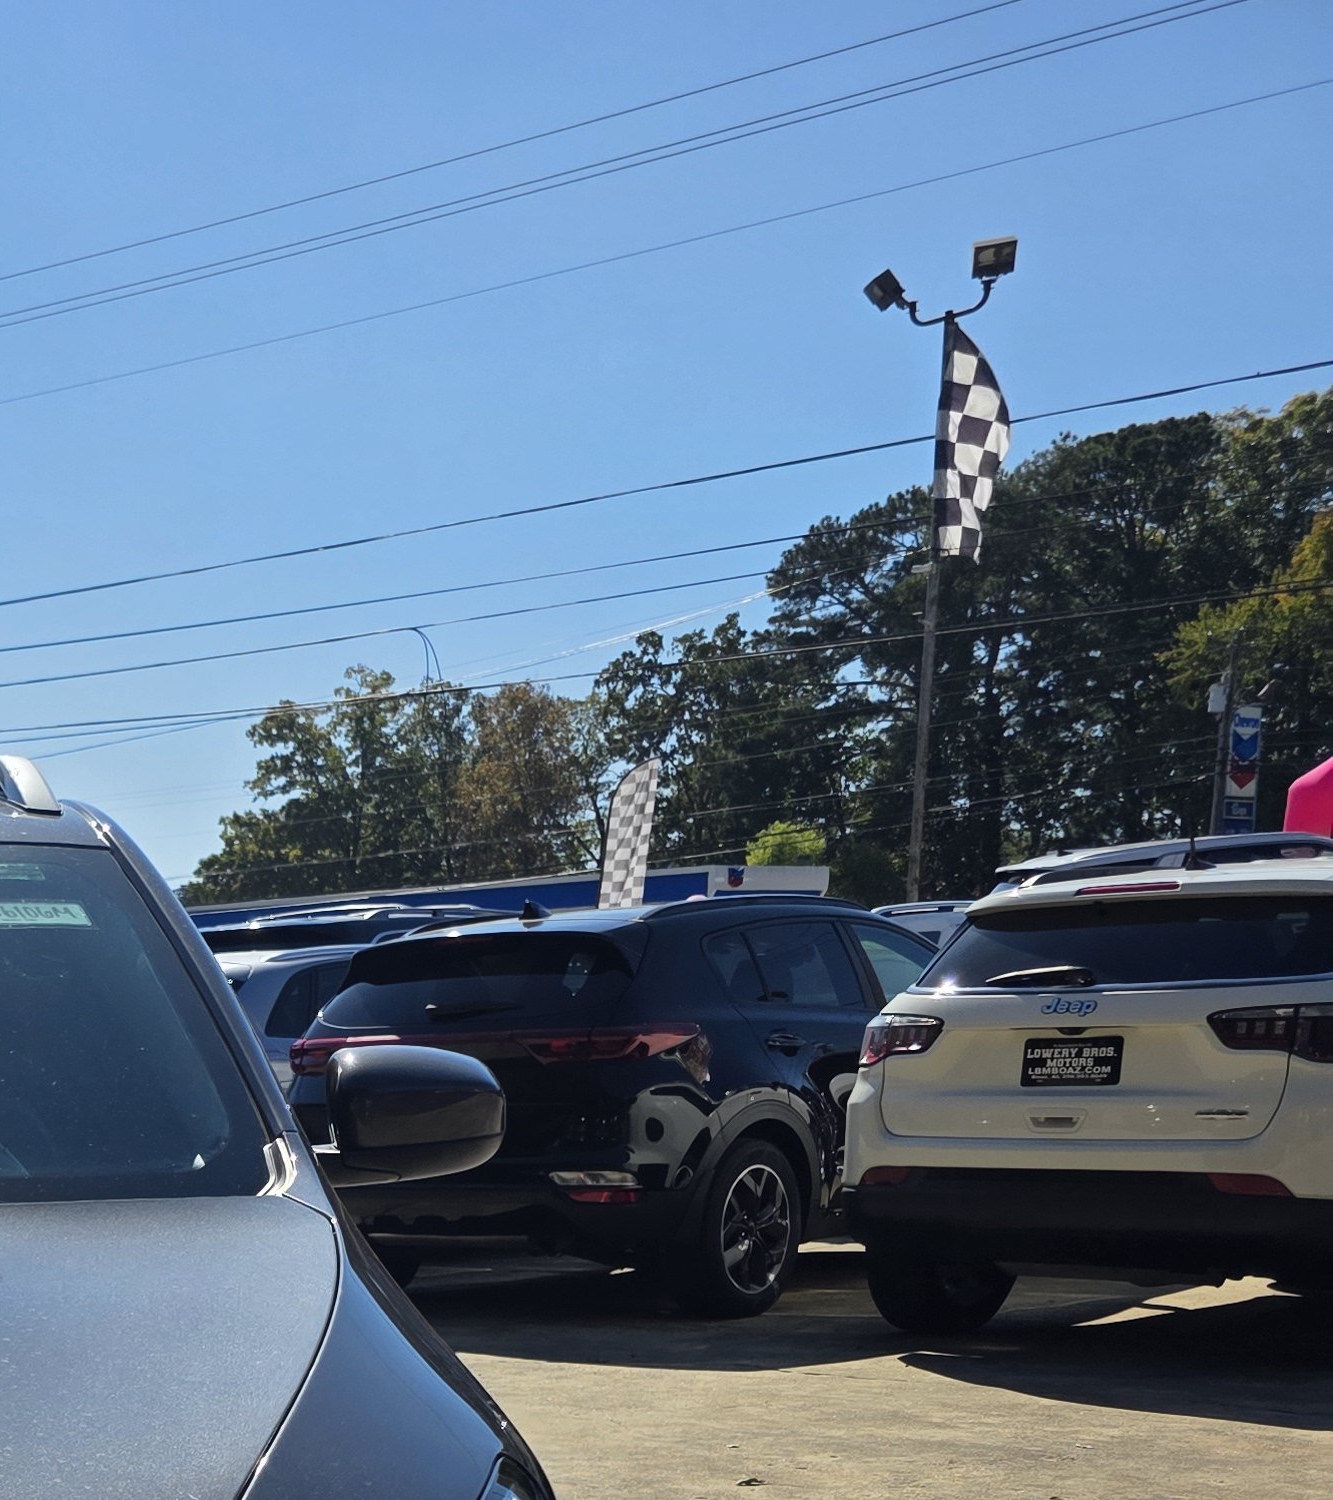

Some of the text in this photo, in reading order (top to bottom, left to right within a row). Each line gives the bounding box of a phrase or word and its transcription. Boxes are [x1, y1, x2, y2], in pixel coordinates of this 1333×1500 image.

[1041, 997, 1098, 1018] Jeep
[1026, 1046, 1117, 1059] LOWERY BROS.
[1046, 1057, 1094, 1068] MOTORS
[1027, 1065, 1112, 1075] LBMBOAZ.COM
